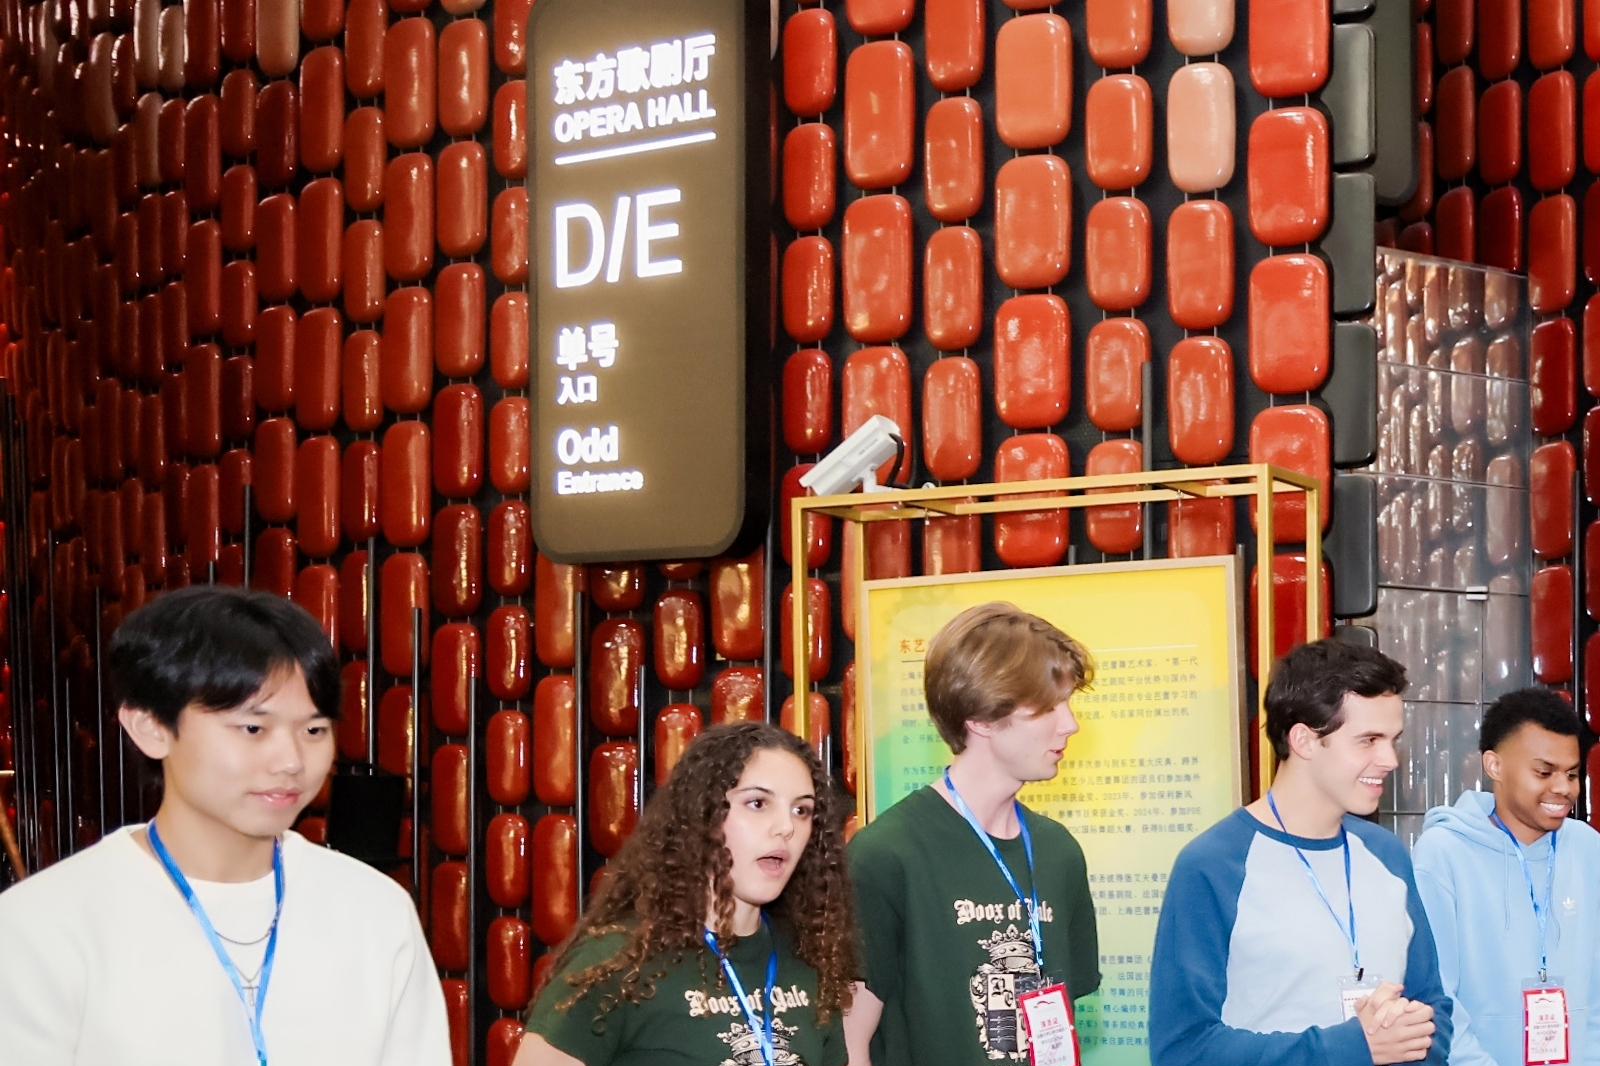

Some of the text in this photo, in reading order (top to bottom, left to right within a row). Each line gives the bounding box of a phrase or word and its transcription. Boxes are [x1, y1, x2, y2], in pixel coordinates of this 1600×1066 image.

[553, 34, 716, 104] 东方歌剧厅
[554, 90, 716, 143] OPERA HALL
[555, 188, 683, 288] D/E
[557, 323, 619, 371] 单号
[557, 375, 598, 404] 入口
[557, 426, 619, 465] Odd
[557, 469, 644, 496] Entrance
